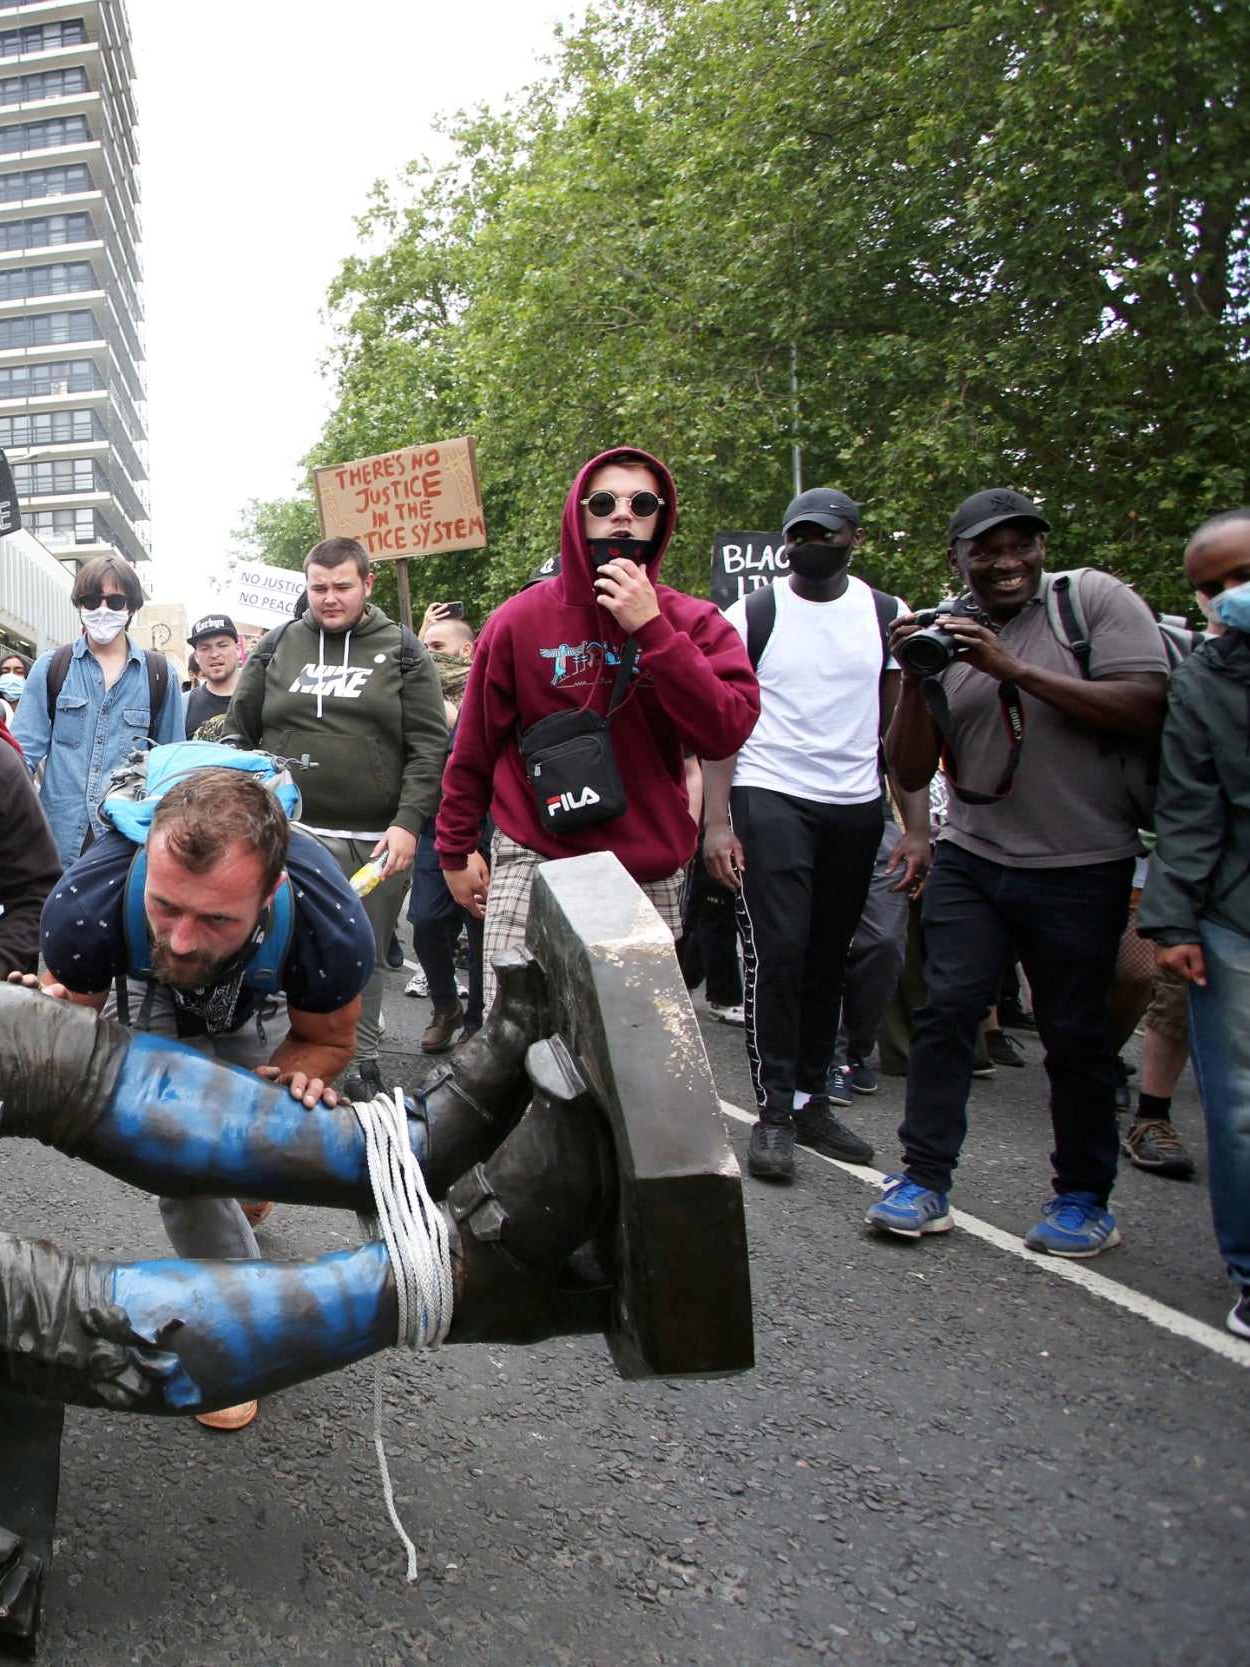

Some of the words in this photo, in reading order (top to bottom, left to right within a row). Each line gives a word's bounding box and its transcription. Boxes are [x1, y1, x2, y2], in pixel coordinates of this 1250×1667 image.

[335, 454, 405, 491] THERE'S
[412, 449, 441, 471] NO
[355, 470, 442, 513] JUSTICE
[372, 510, 389, 528] IN
[395, 500, 434, 522] THE
[353, 526, 407, 553] TICE
[411, 516, 486, 549] SYSTEM
[722, 543, 790, 574] BLAC
[239, 592, 259, 604] NO
[241, 572, 261, 584] NO
[262, 576, 304, 594] JUSTIC
[288, 663, 374, 697] NIKE
[1008, 706, 1022, 740] Canon
[547, 786, 600, 817] FILA
